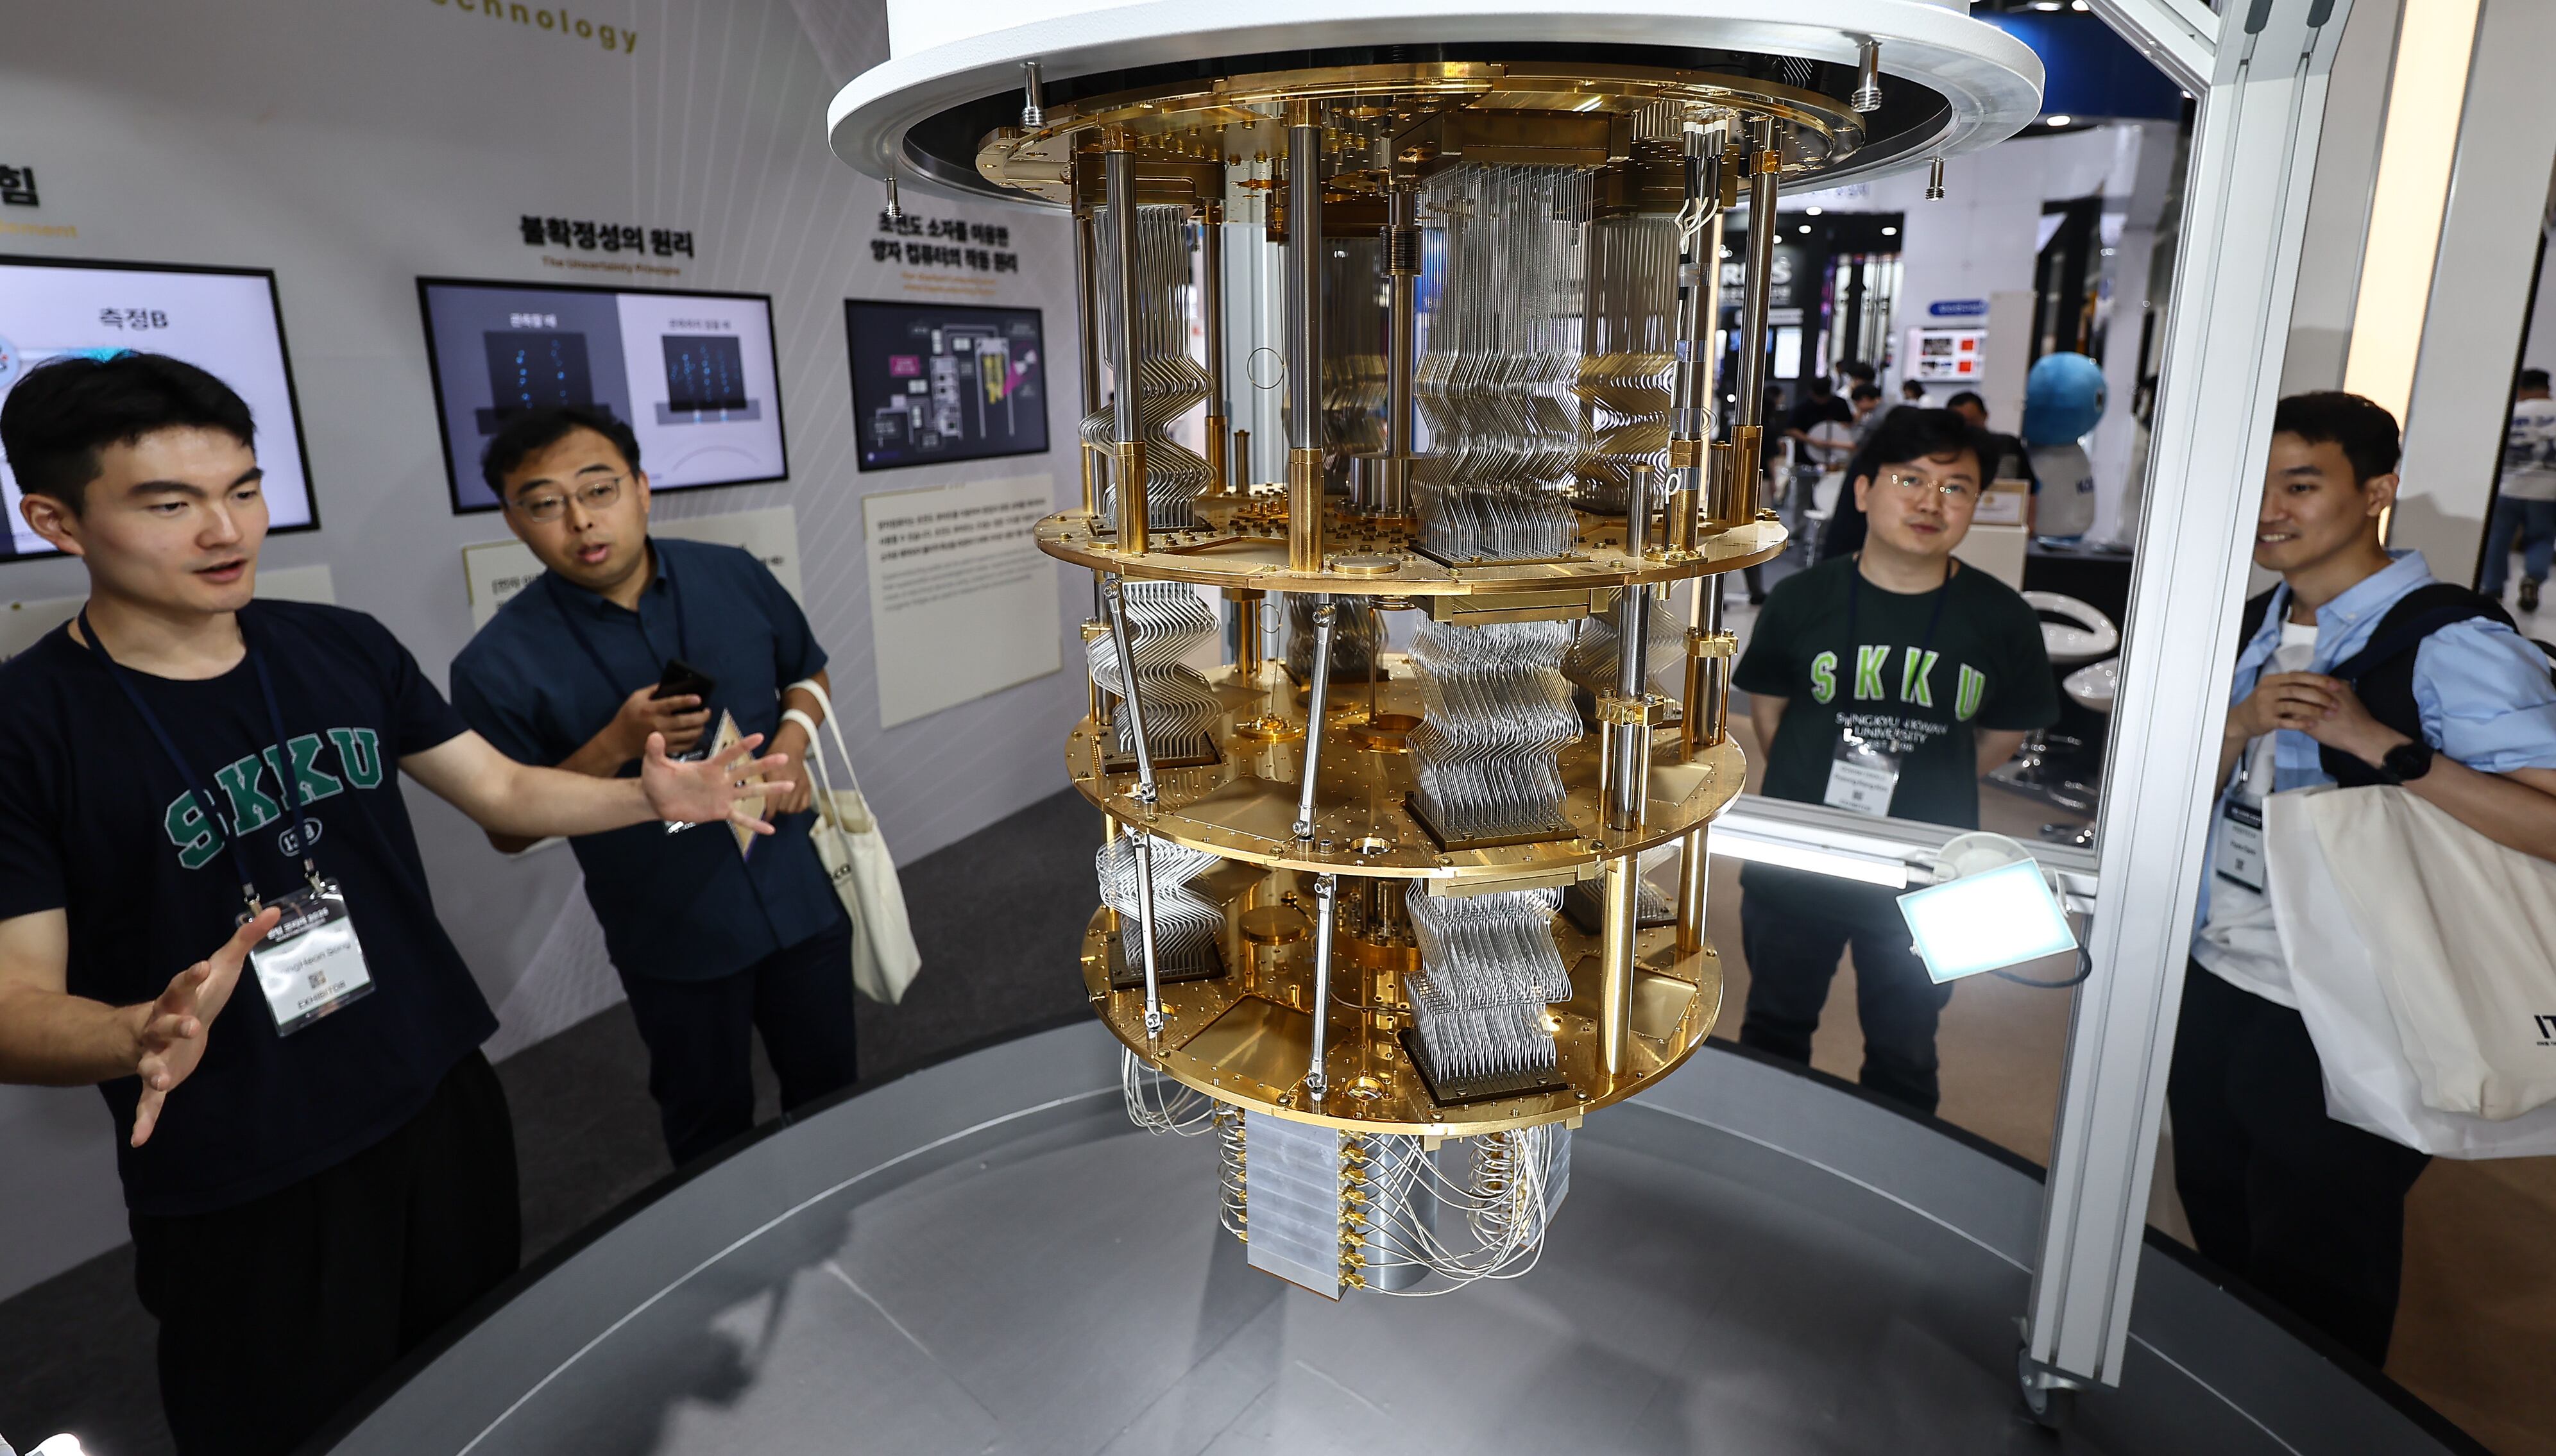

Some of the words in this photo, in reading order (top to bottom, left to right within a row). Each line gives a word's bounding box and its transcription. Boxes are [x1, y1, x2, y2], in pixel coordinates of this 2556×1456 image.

[430, 0, 637, 55] chnology
[520, 215, 643, 255] 불확정성의
[650, 228, 694, 259] 원리
[1810, 645, 1986, 722] SKKU
[164, 727, 383, 869] SKKU
